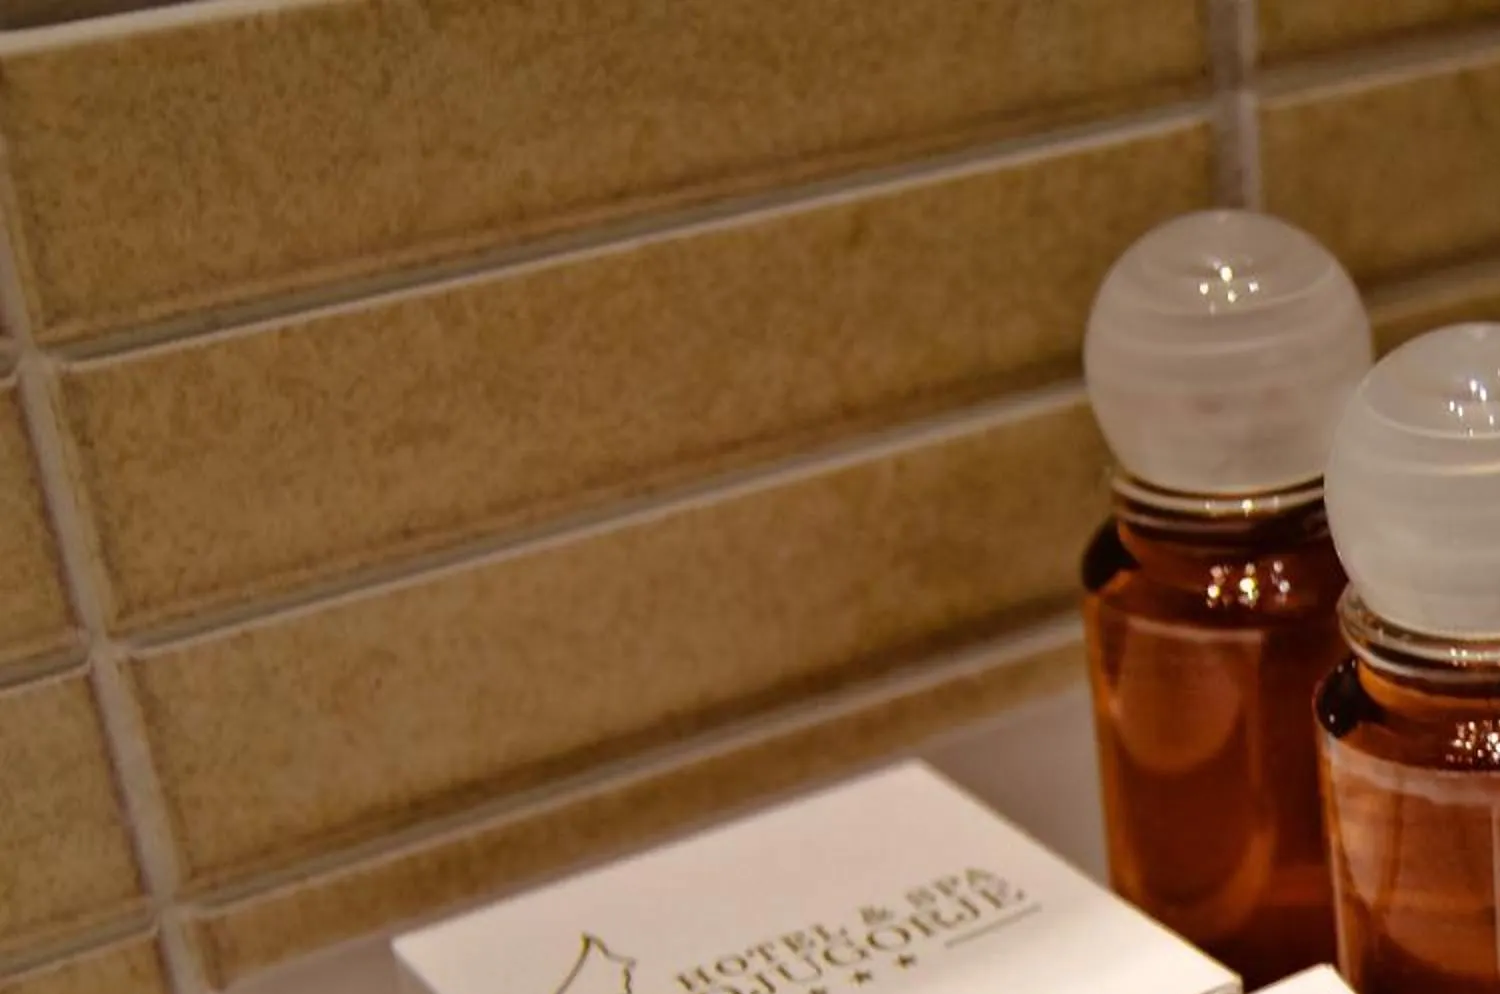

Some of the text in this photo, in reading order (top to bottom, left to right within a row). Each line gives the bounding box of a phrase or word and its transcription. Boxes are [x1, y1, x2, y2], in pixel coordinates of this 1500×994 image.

[673, 865, 996, 993] HOTEL & SPA
